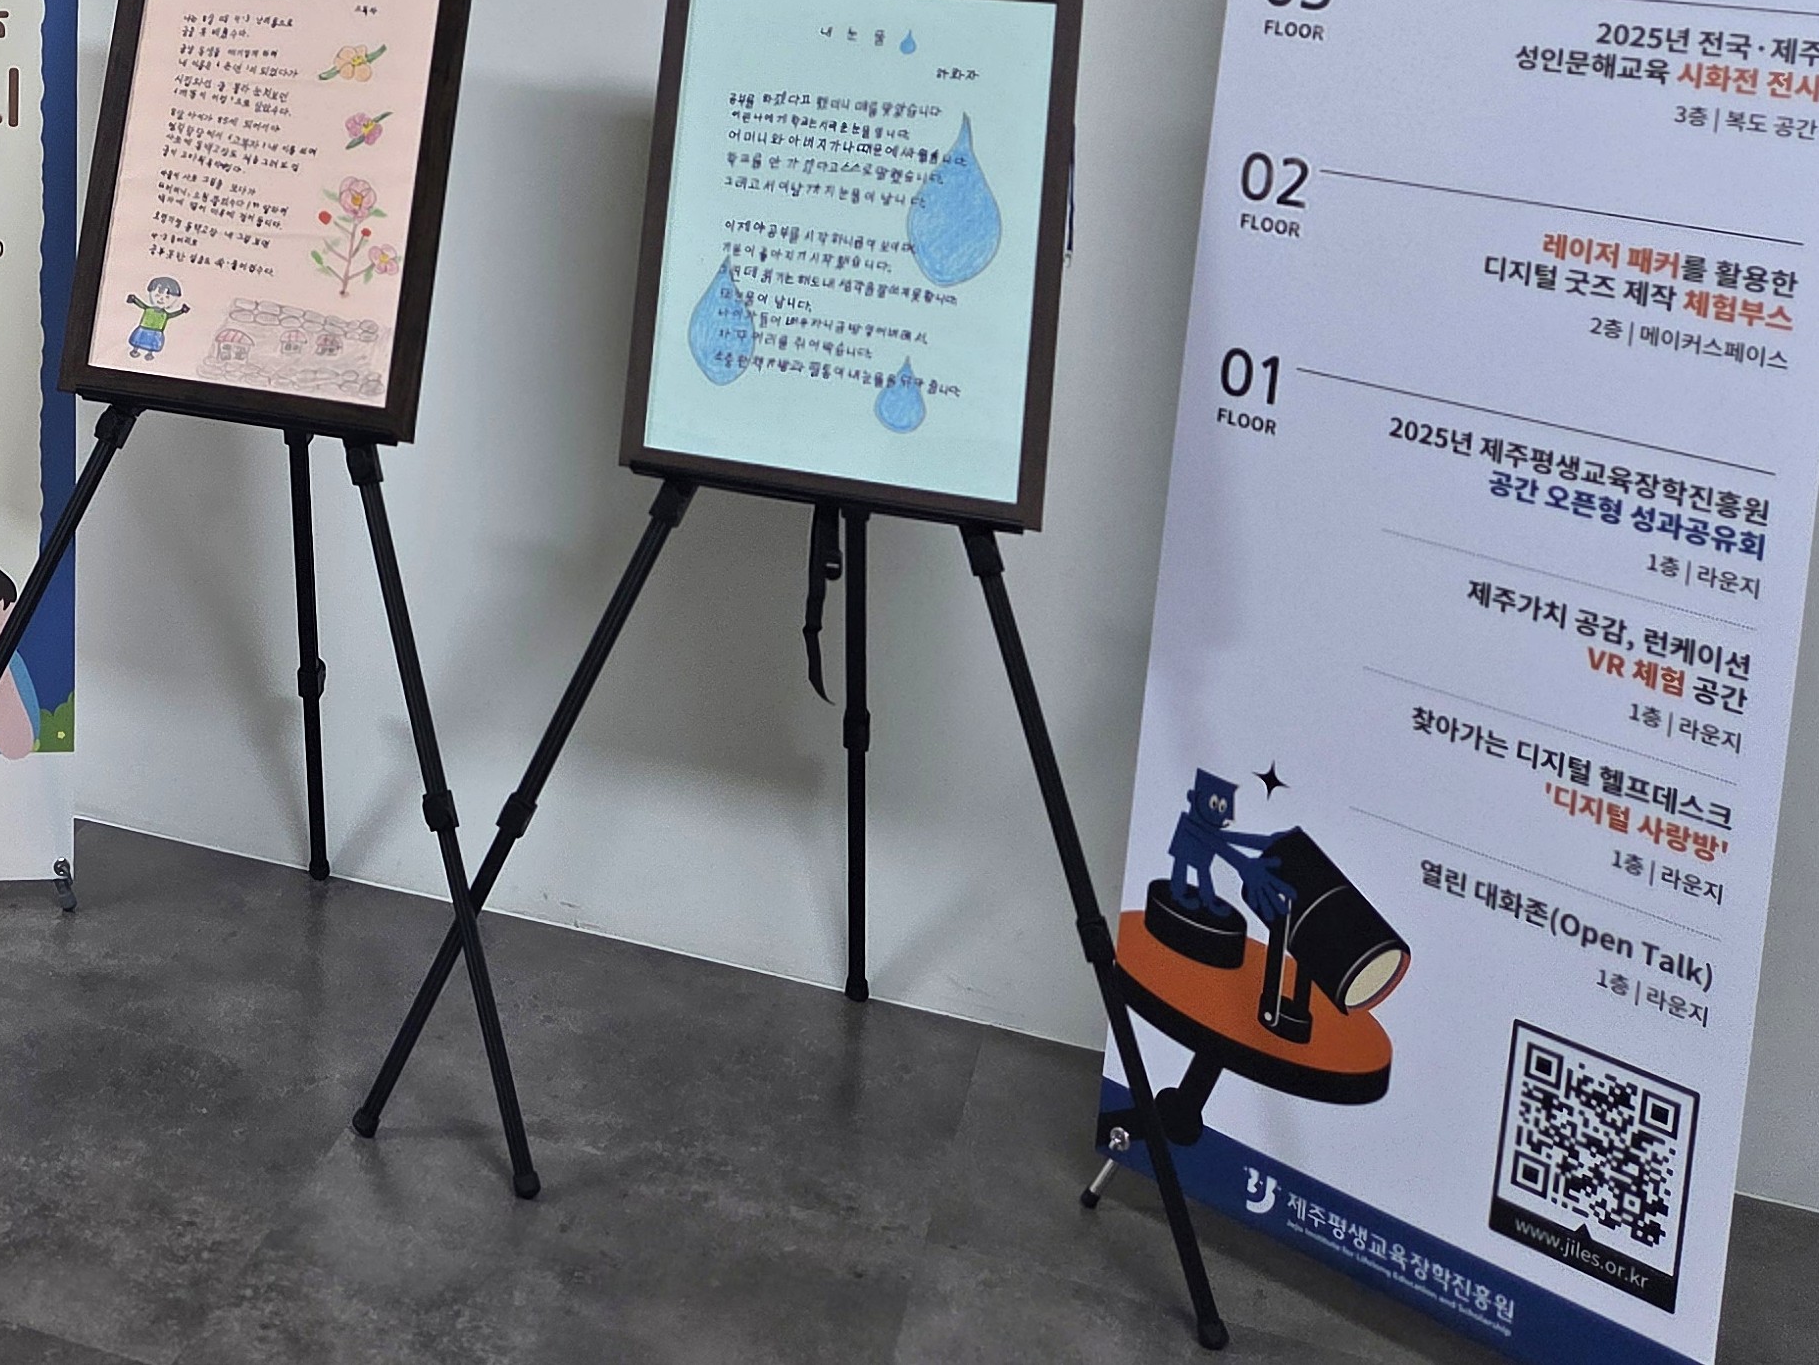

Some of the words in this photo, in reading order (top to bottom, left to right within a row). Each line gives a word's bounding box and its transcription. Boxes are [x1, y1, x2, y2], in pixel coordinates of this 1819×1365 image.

[1263, 19, 1325, 42] FLOOR
[1595, 23, 1690, 55] 2025년
[1515, 45, 1670, 85] 성인문해교육
[1676, 62, 1760, 96] 시화전
[1673, 105, 1708, 127] 3층
[1725, 110, 1768, 133] 복도
[1772, 115, 1819, 141] 공간
[1240, 152, 1310, 209] 02
[1239, 214, 1301, 238] FLOOR
[1483, 255, 1558, 292] 디지털
[1563, 268, 1617, 299] 굿즈
[1622, 280, 1678, 312] 제작
[1682, 288, 1795, 332] 체험부스
[1542, 233, 1622, 269] 레이저
[1627, 246, 1709, 283] 패커를
[1714, 259, 1800, 299] 활용한
[1589, 317, 1623, 340] 2층
[1639, 325, 1789, 370] 메이커스페이스
[1219, 347, 1281, 406] 01
[1216, 407, 1277, 436] FLOOR
[1388, 417, 1474, 457] 2025년
[1478, 436, 1771, 528] 제주평생교육장학진흥원
[1488, 469, 1541, 506] 공간
[1543, 484, 1624, 526] 오픈형
[1630, 503, 1766, 562] 성과공유회
[1646, 553, 1680, 578] 1층
[1696, 564, 1761, 600] 라운지
[1467, 580, 1567, 630] 제주가치
[1574, 608, 1635, 651] 공감,
[1644, 627, 1751, 682] 런케이션
[1587, 646, 1626, 678] VR
[1632, 658, 1686, 697] 체험
[1692, 676, 1748, 715] 공간
[1628, 703, 1663, 729] 1층
[1678, 717, 1742, 754] 라운지
[1411, 706, 1509, 758] 찾아가는
[1516, 741, 1592, 786] 디지털
[1599, 764, 1734, 832] 헬프데스크
[1611, 850, 1645, 877] 1층
[1661, 868, 1725, 906] 라운지
[1419, 858, 1468, 899] 열린
[1473, 881, 1633, 960] 대화존(Open
[1642, 946, 1715, 994] Talk)
[1595, 968, 1631, 998] 1층
[1646, 988, 1710, 1028] 라운지
[1287, 1192, 1515, 1325] 제주평생교육장학진흥원
[1514, 1216, 1651, 1290] www.jiles.or.kr
